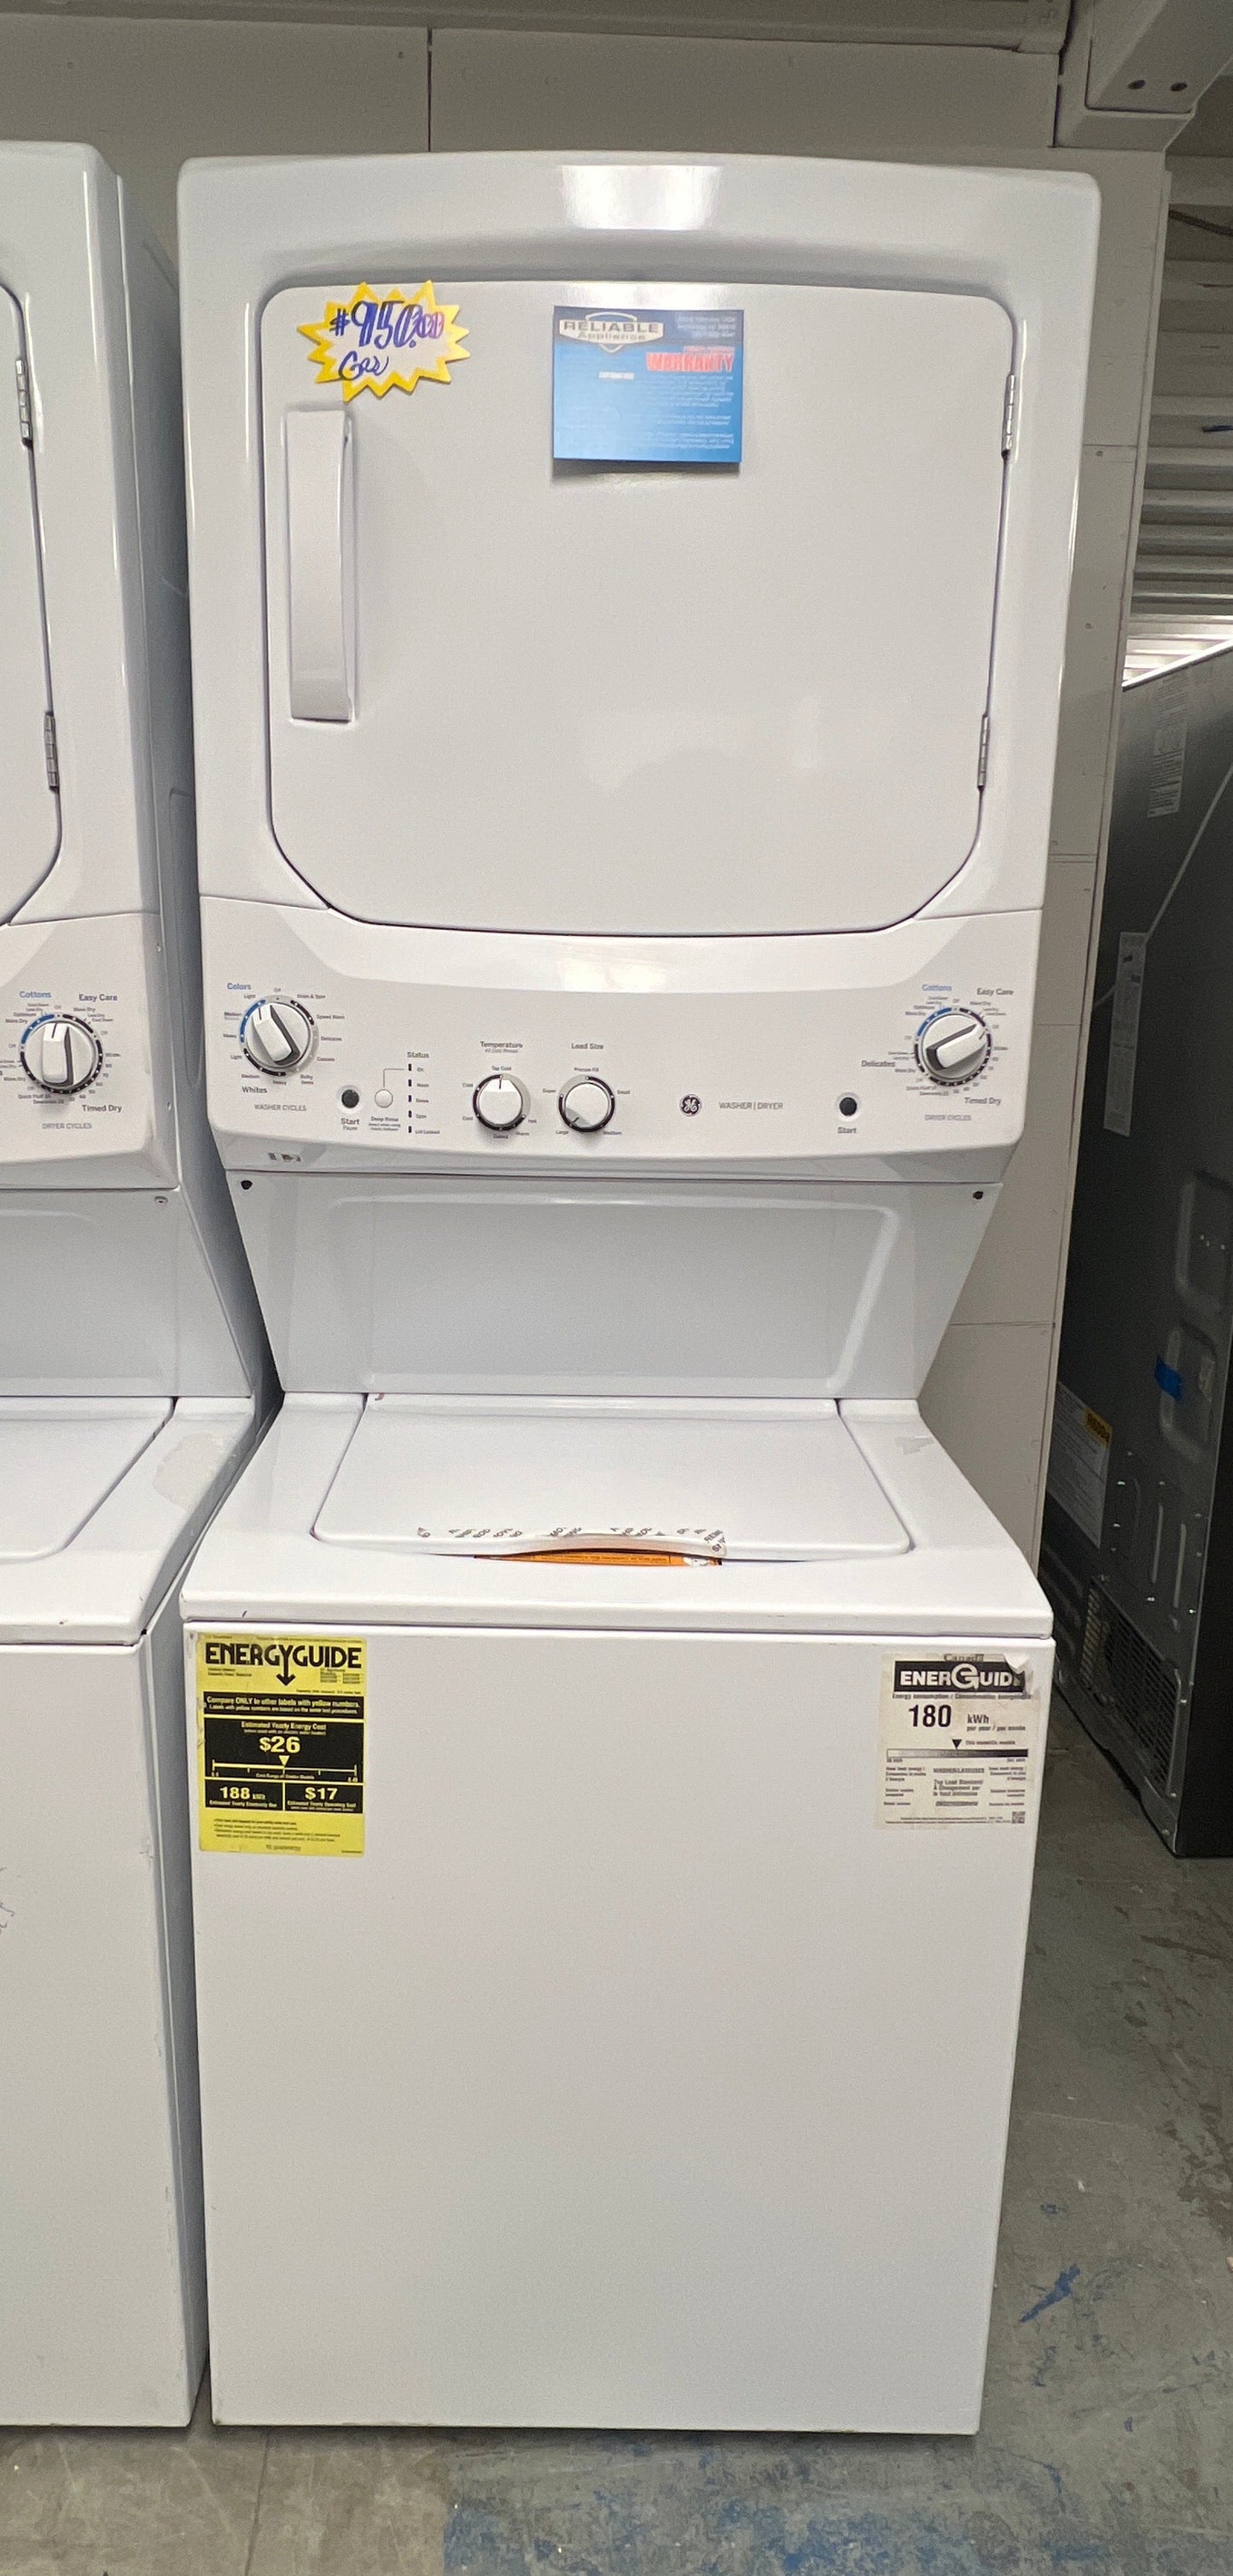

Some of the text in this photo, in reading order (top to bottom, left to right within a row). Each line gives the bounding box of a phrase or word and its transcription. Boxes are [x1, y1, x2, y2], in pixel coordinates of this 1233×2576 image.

[563, 321, 659, 333] RELIABLE
[578, 331, 646, 340] Appliance
[339, 351, 389, 380] Gas
[646, 352, 734, 372] WARRANTY
[206, 1643, 362, 1668] ENERGYGUIDE
[909, 1705, 989, 1727] 180 kWh
[272, 1722, 289, 1730] Yearly
[290, 1723, 311, 1731] Energy
[259, 1736, 301, 1753] $26
[220, 1787, 250, 1800] 188
[305, 1788, 338, 1800] $17
